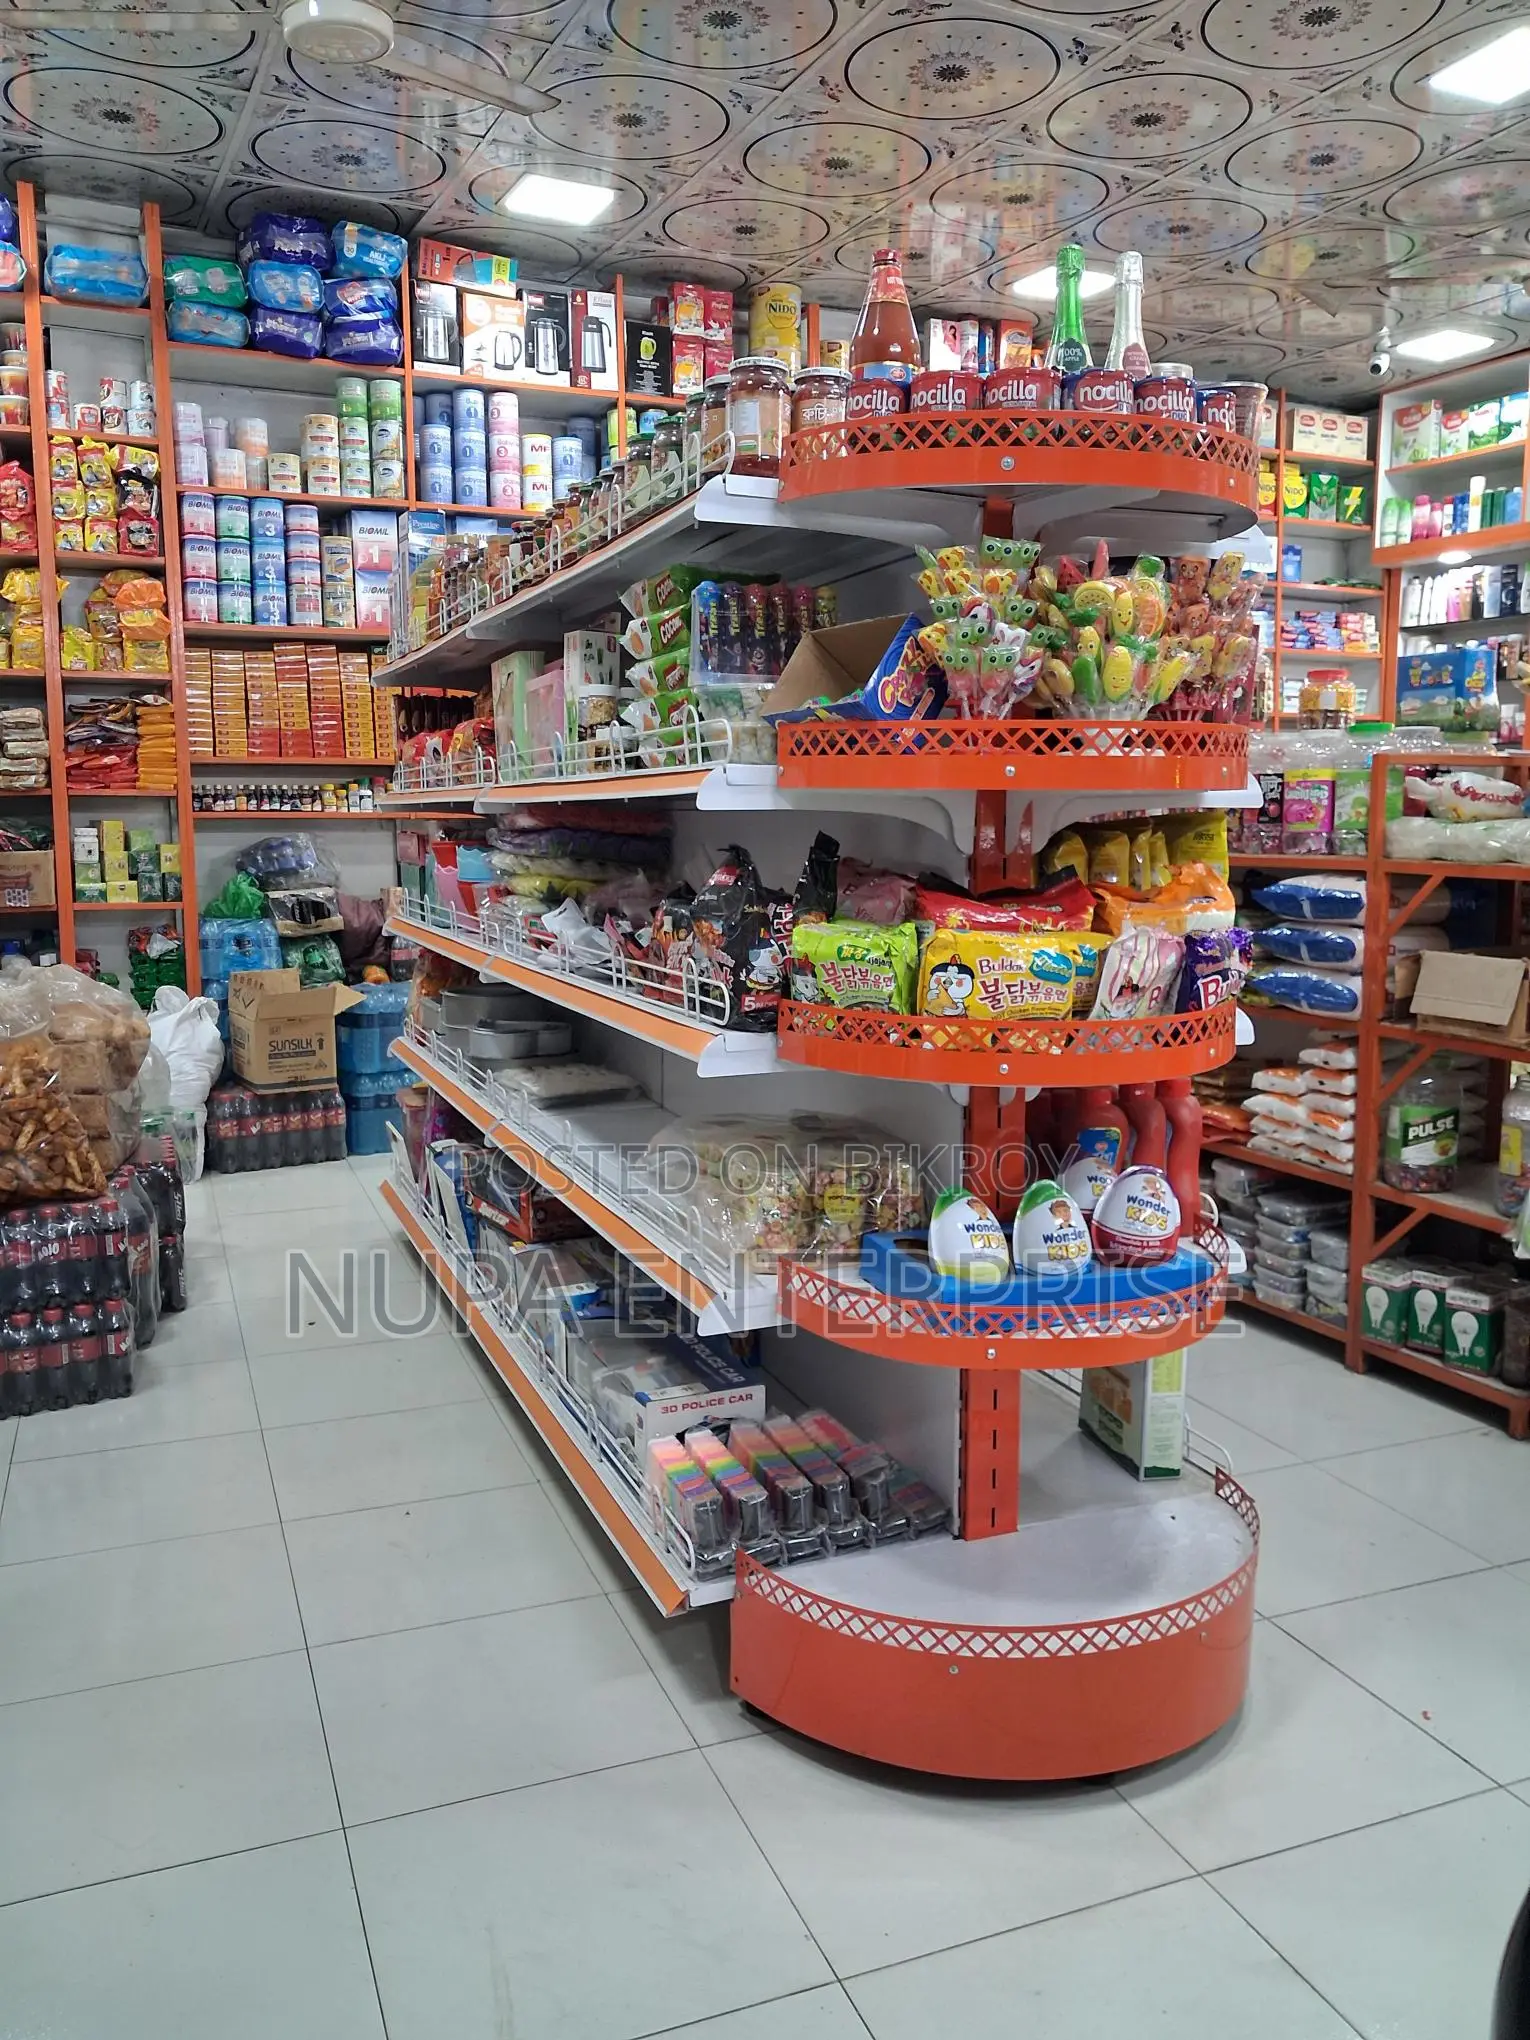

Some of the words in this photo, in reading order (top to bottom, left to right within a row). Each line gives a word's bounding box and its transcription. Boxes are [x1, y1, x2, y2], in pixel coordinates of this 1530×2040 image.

[767, 302, 797, 313] NIDO
[911, 383, 967, 408] nocilla
[985, 380, 1037, 405] nocilla
[1136, 387, 1195, 414] nocilla
[1285, 487, 1304, 495] NIDO
[358, 526, 389, 535] BIOMIL
[744, 996, 755, 1011] 5
[978, 979, 1069, 1012] 불닭볶음면
[268, 1037, 313, 1051] SUNSILK
[1408, 1115, 1455, 1140] PULSE
[1127, 1194, 1171, 1217] Wonder
[964, 1222, 1001, 1234] Wonde
[1126, 1206, 1168, 1231] KIDS
[1042, 1230, 1087, 1246] Wonder
[1047, 1243, 1089, 1260] KIDS
[661, 1405, 678, 1415] 3D
[682, 1397, 725, 1411] POLICE
[729, 1393, 753, 1404] CAR
